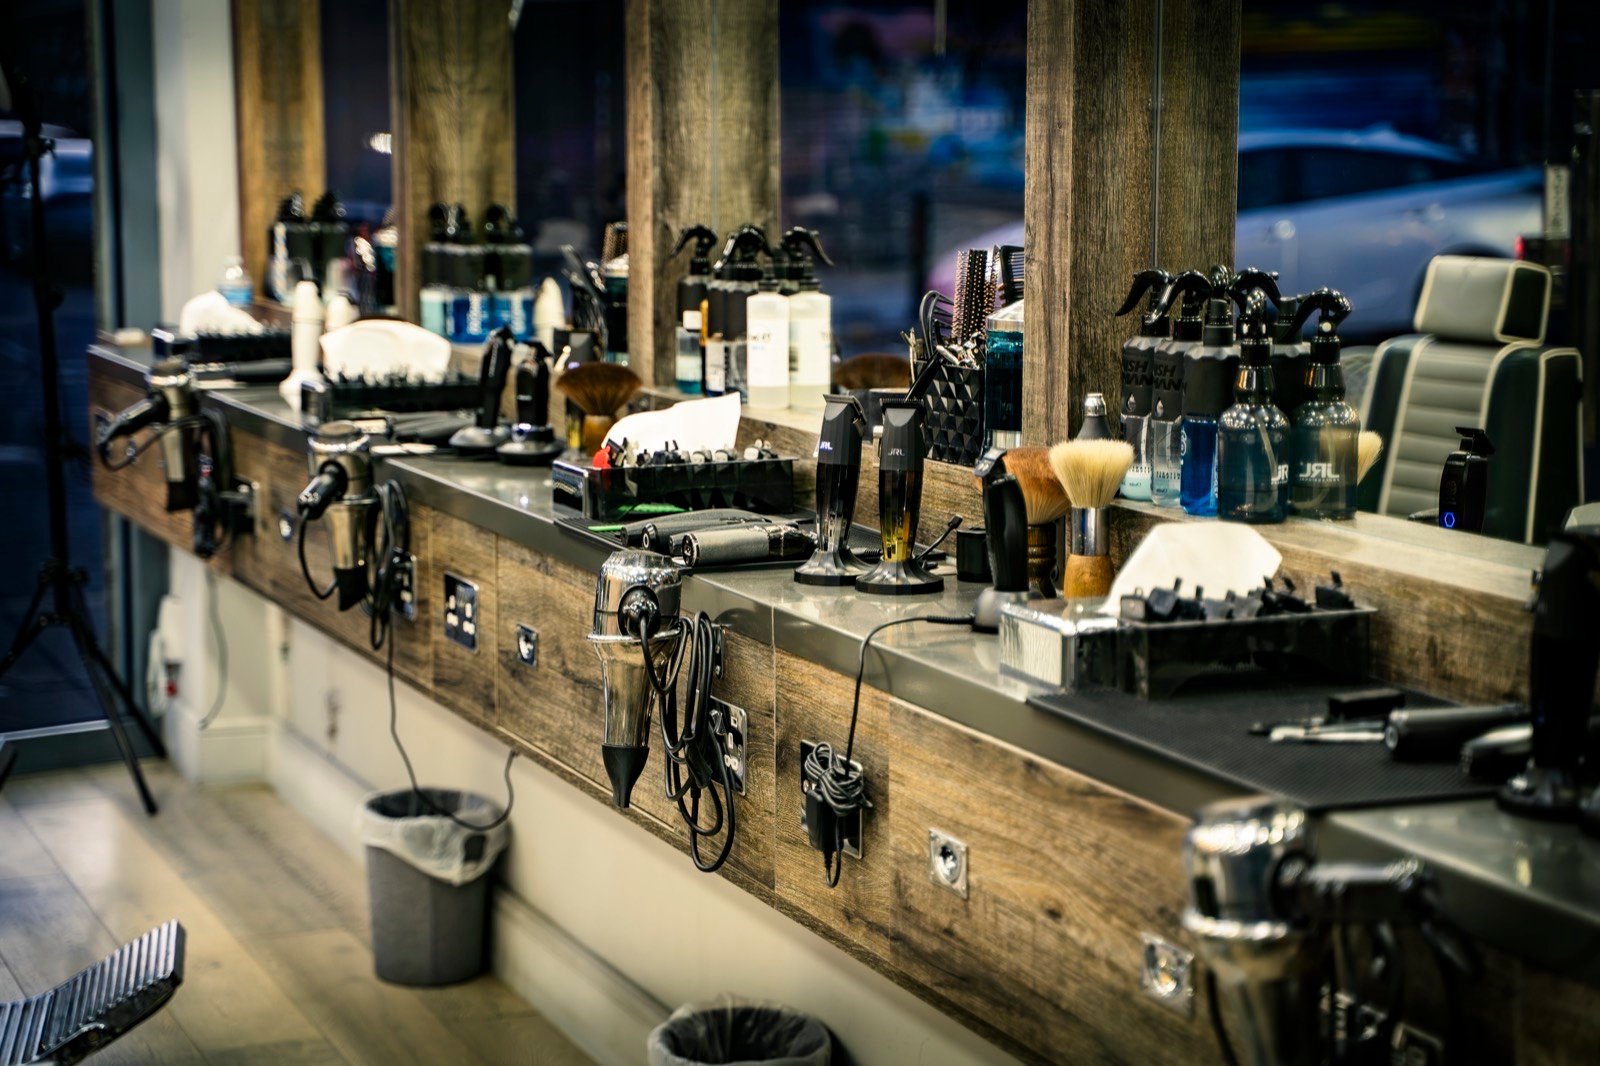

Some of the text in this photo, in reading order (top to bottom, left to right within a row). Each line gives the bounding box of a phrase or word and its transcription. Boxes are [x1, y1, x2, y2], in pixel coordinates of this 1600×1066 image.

[820, 441, 833, 450] JRL
[888, 448, 905, 456] JRL
[1271, 464, 1288, 481] JR
